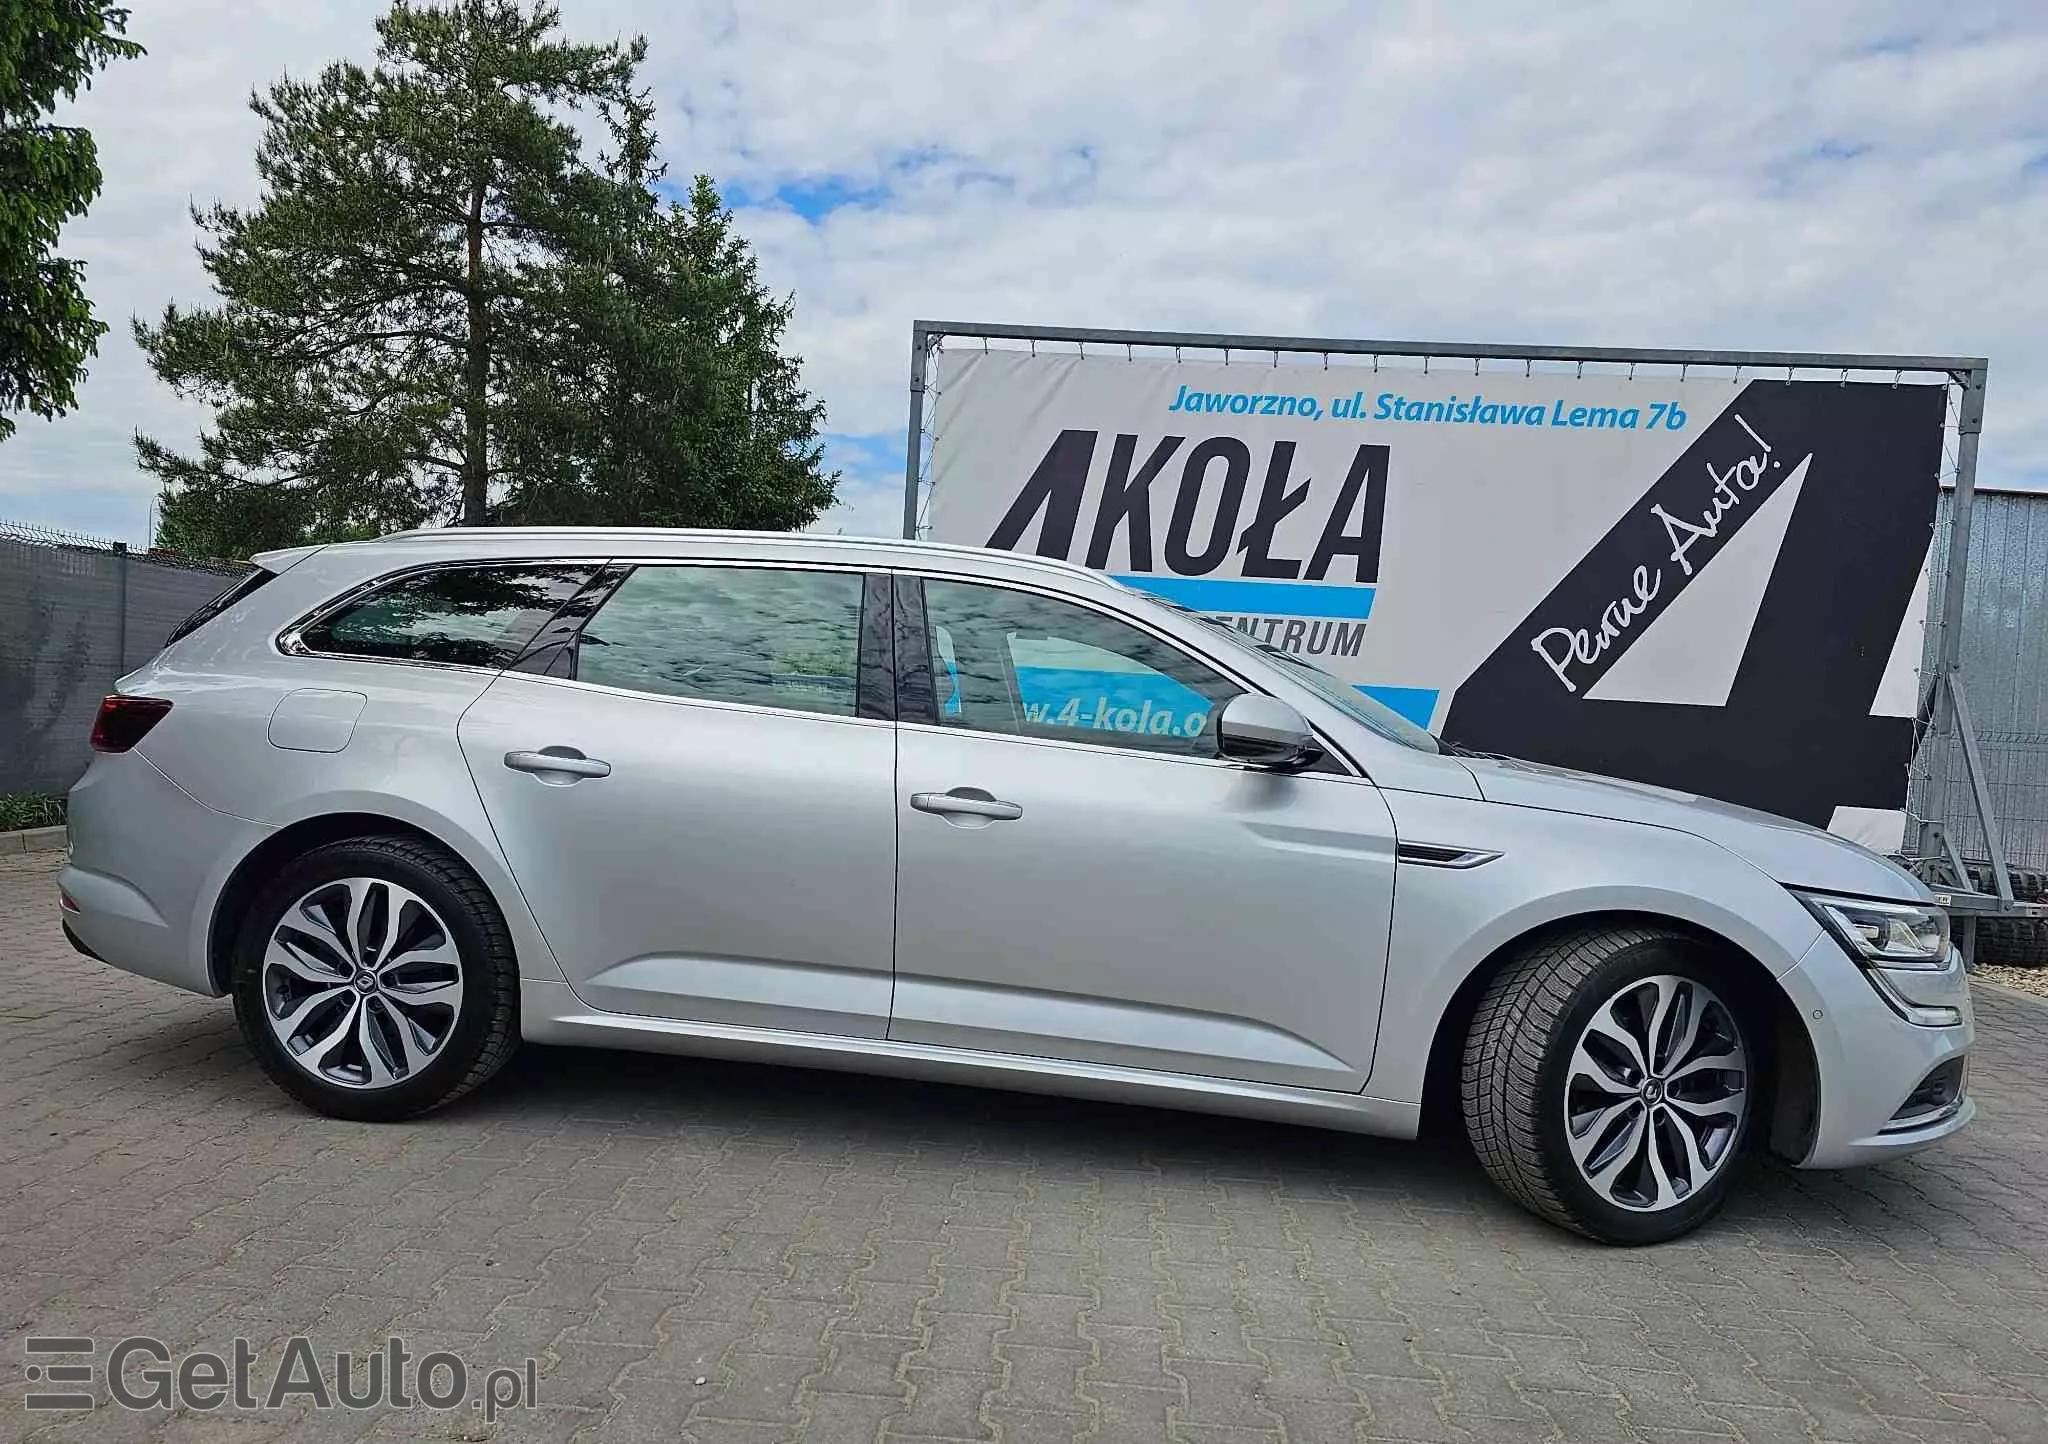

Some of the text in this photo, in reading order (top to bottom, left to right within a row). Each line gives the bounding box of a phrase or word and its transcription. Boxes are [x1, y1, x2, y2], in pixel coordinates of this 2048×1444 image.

[1168, 384, 1687, 430] Jaworzno, ul. Stanisława Lema 7b
[1650, 414, 1781, 576] Auta!
